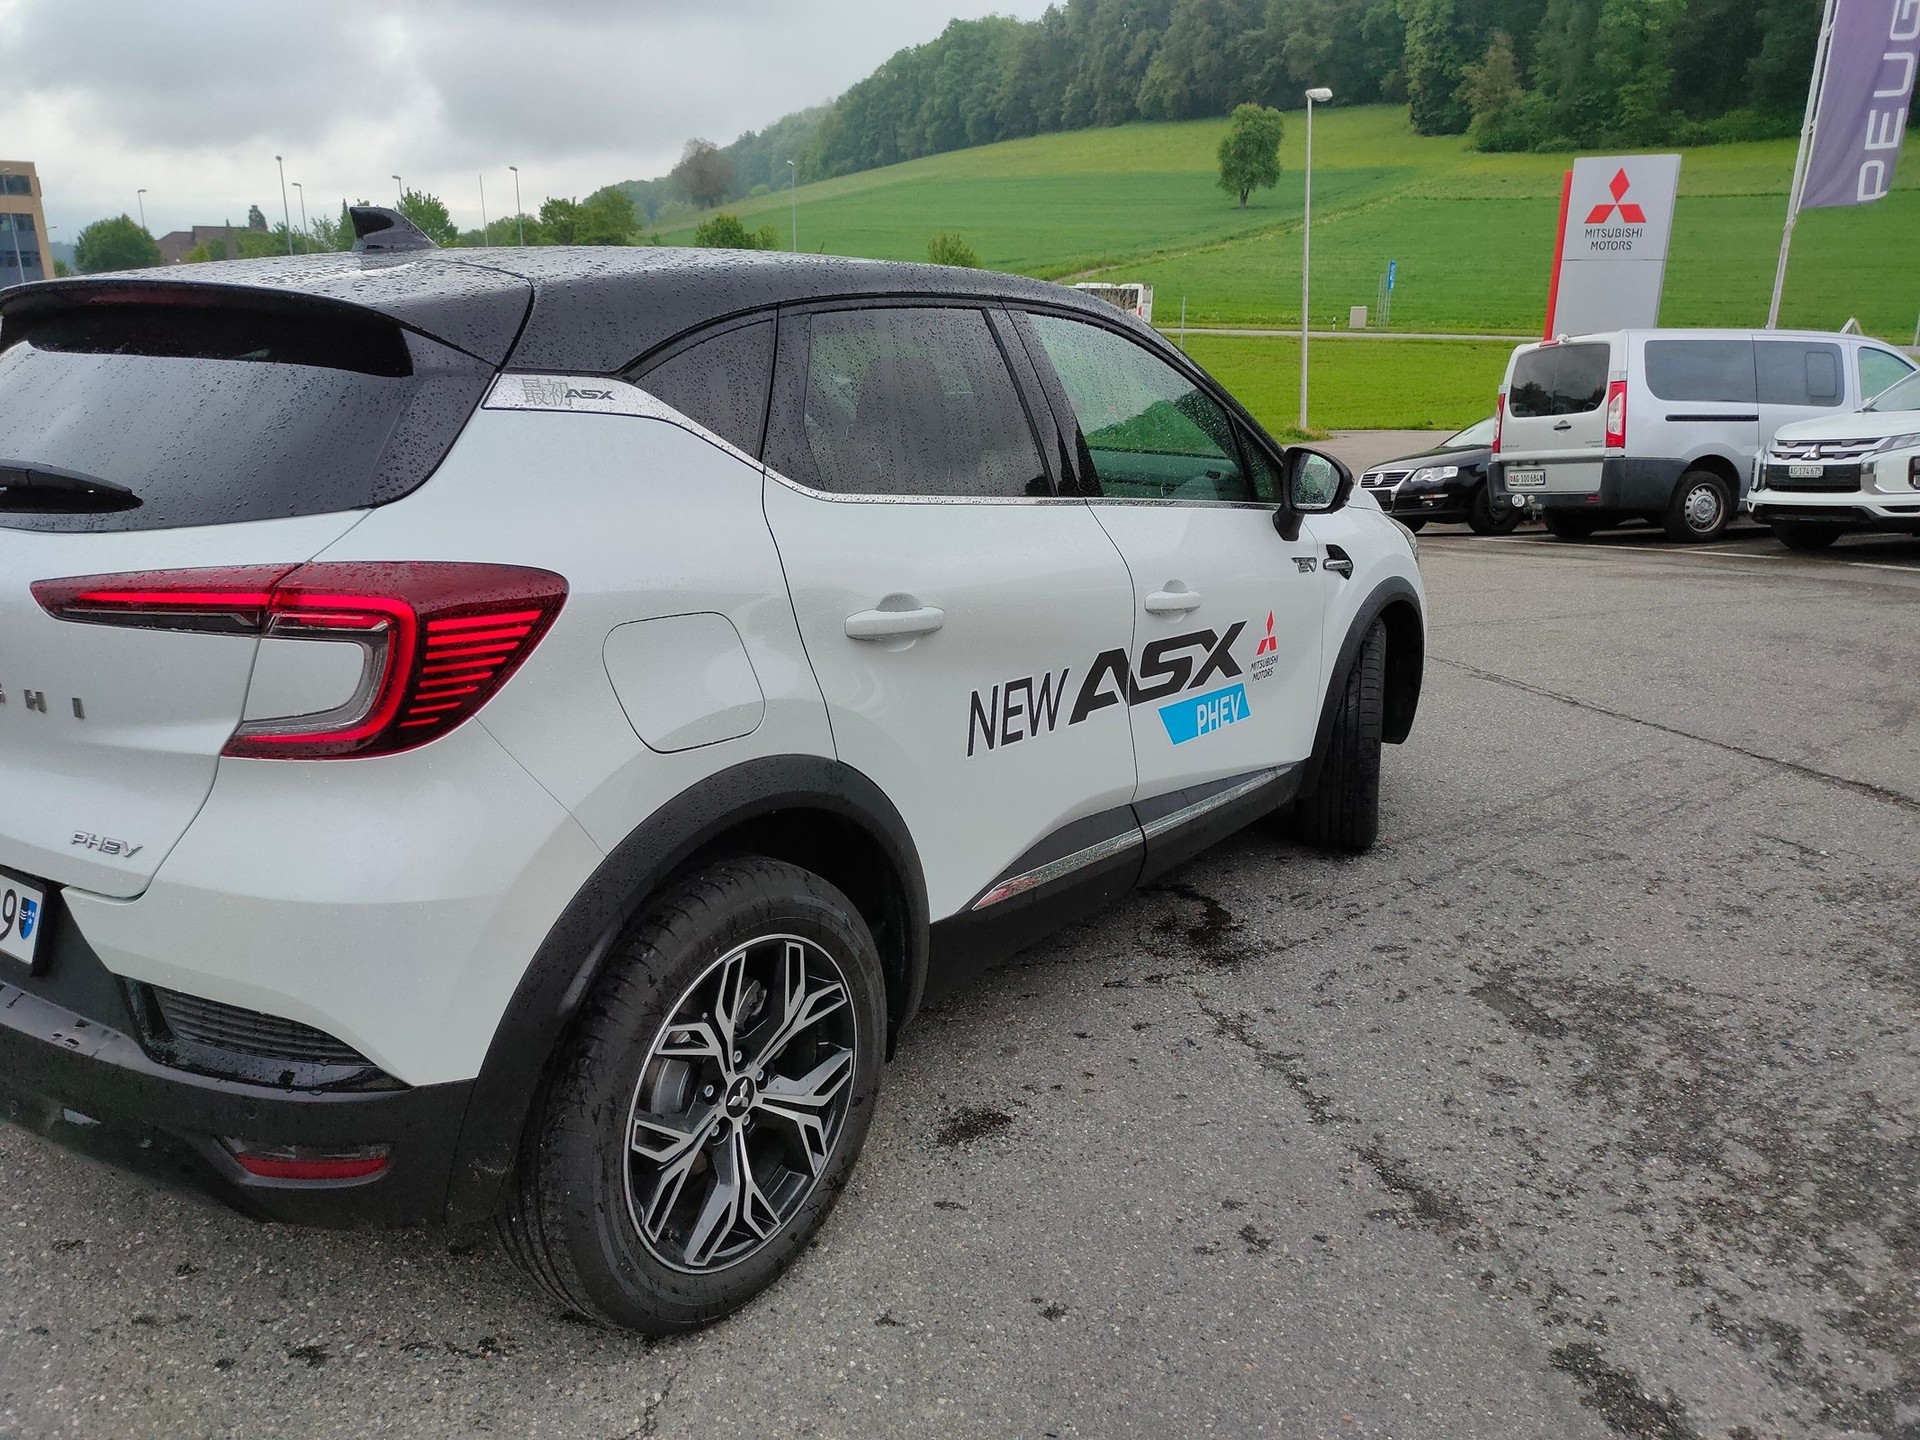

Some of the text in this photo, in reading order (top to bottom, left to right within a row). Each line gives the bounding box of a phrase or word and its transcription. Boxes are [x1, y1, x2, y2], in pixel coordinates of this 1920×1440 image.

[1584, 228, 1643, 239] MITSUBISHI
[1590, 241, 1632, 251] MOTORS
[565, 389, 616, 401] ASX
[1513, 495, 1523, 506] CH
[1250, 654, 1279, 672] MITSUBISHI
[1252, 667, 1274, 682] MOTORS
[966, 620, 1247, 759] NEW ASX
[0, 682, 86, 720] HI
[1196, 691, 1245, 737] PHEV
[69, 829, 143, 858] PHEV
